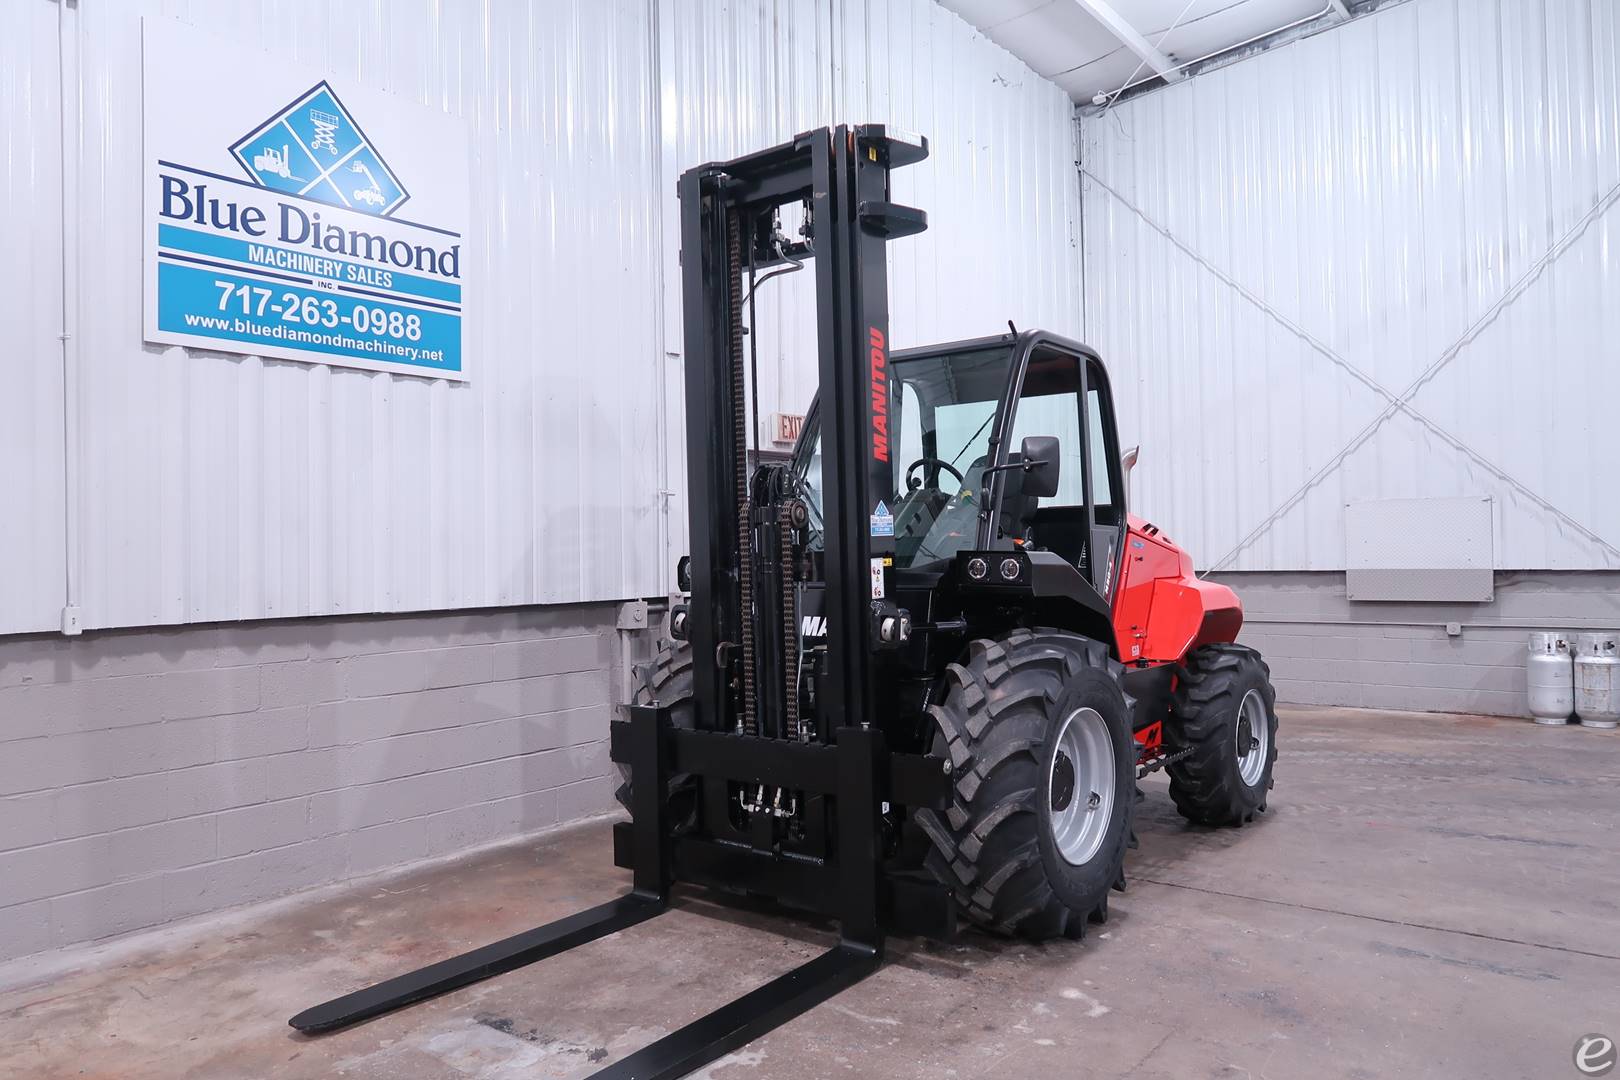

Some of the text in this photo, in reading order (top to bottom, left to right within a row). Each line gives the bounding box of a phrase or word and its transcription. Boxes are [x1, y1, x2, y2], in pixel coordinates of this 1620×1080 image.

[159, 174, 461, 278] Blue Diamond
[248, 244, 392, 288] MACHINERY SALES
[317, 280, 336, 290] INC.
[214, 280, 422, 341] 717-263-0988
[185, 313, 444, 362] www.bluediamondmachinery.net
[870, 326, 888, 463] MANITOU
[782, 415, 803, 440] EXIT
